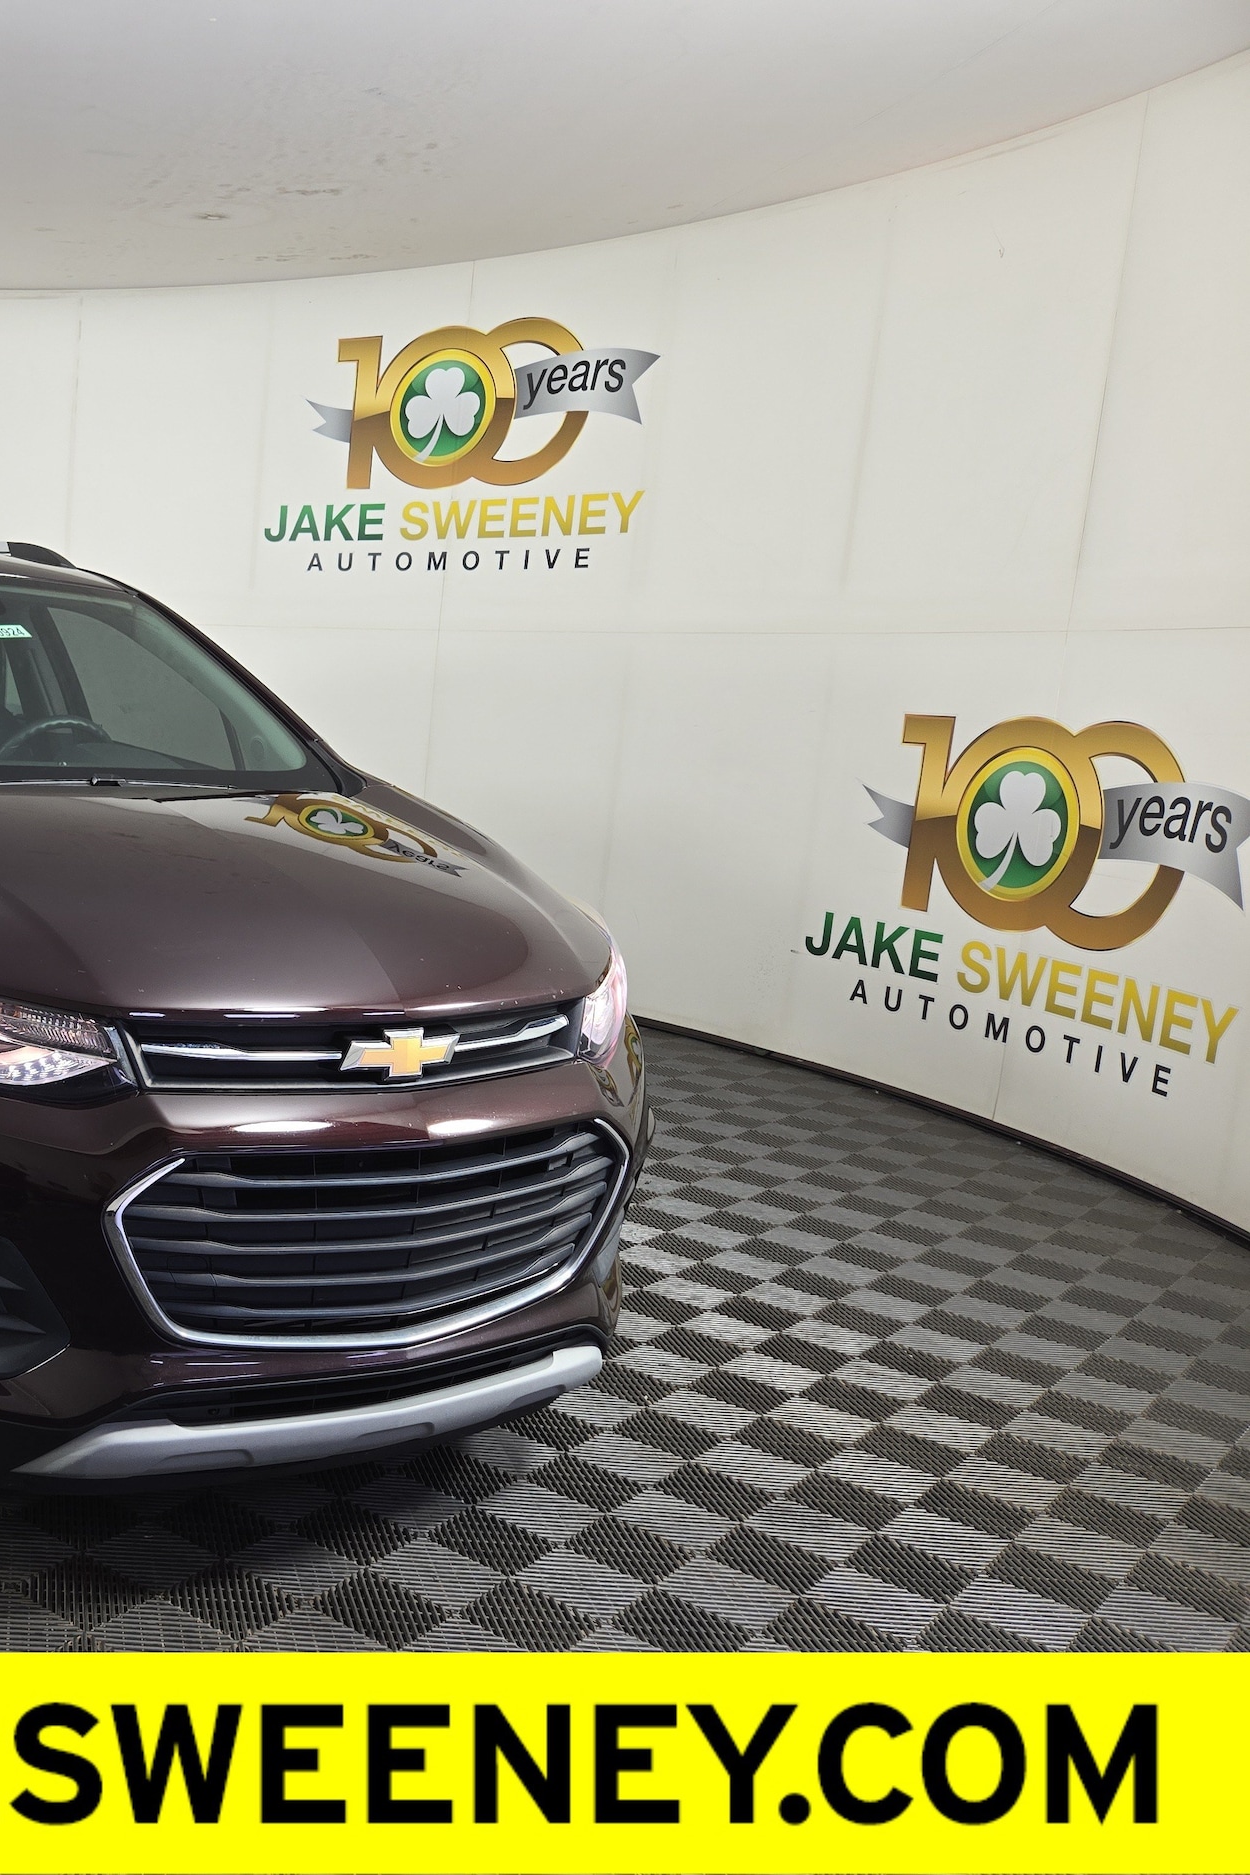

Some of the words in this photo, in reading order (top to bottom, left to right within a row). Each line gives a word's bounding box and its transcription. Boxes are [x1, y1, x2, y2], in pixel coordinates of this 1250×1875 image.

[338, 316, 589, 489] 100
[523, 357, 627, 410] years
[264, 503, 386, 542] JAKE
[399, 490, 646, 541] SWEENEY
[308, 547, 591, 572] AUTOMOTIVE
[901, 714, 1186, 952] 100
[1109, 794, 1233, 854] years
[805, 911, 944, 983] JAKE
[956, 941, 1239, 1065] SWEENEY
[850, 979, 1172, 1097] AUTOMOTIVE
